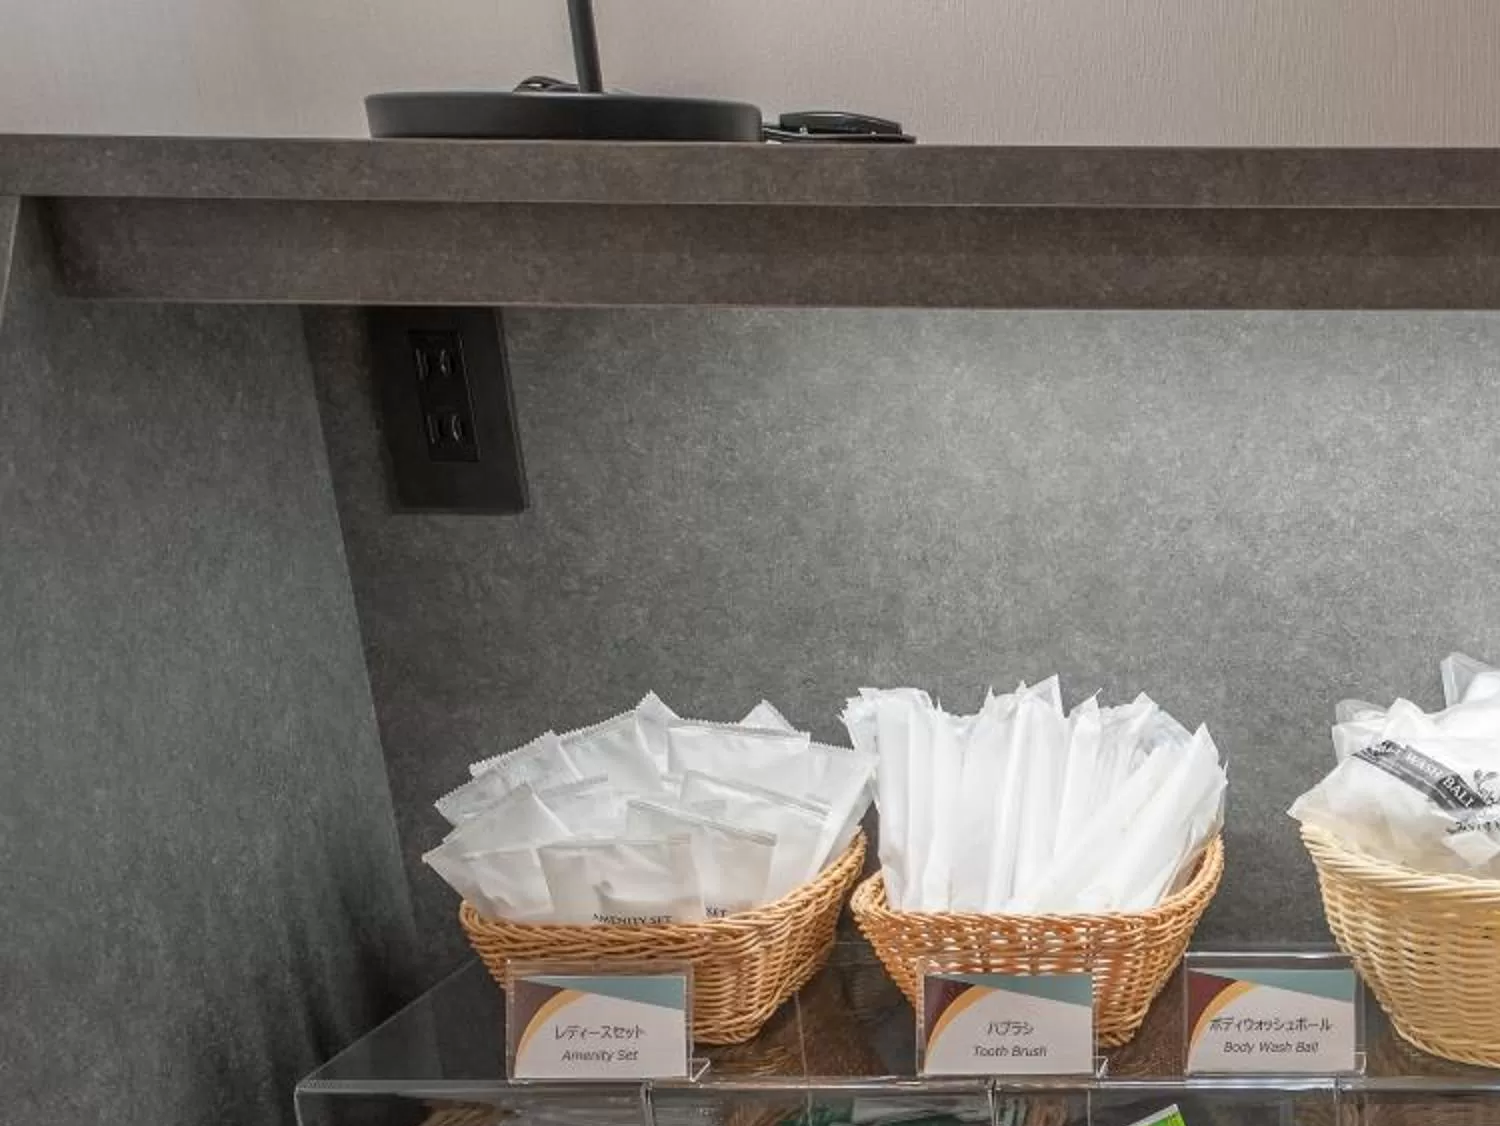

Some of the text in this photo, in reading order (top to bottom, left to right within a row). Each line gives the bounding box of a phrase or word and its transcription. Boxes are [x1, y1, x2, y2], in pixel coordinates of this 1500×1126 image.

[554, 1024, 646, 1040] レディースセット
[973, 1045, 1047, 1056] Tooth Brush
[1223, 1041, 1255, 1055] Body
[1259, 1041, 1292, 1053] Wash
[561, 1049, 640, 1062] Amenity Set
